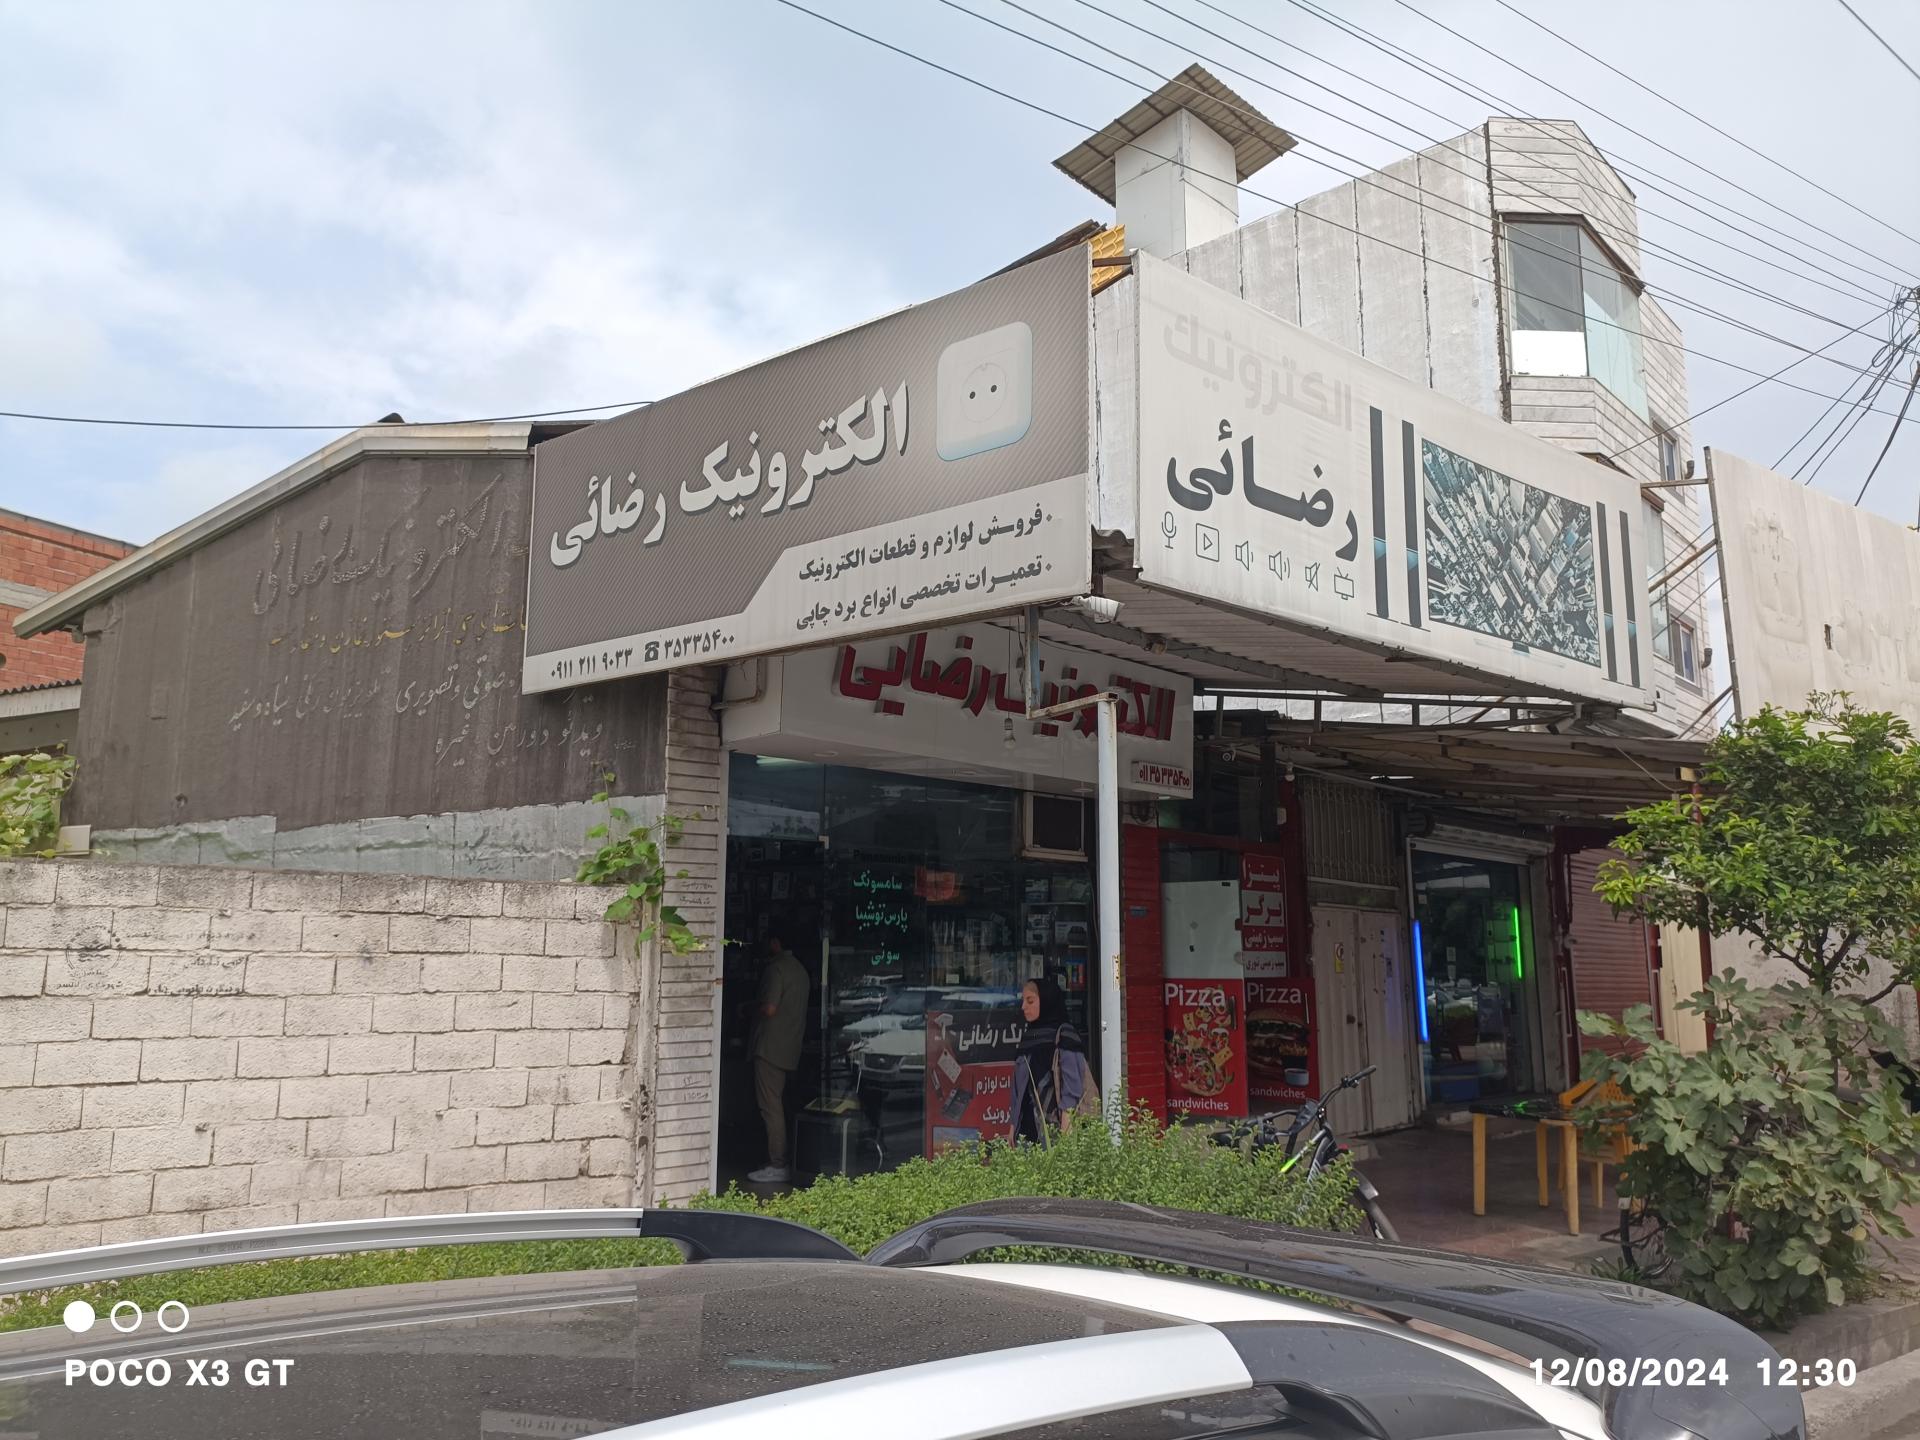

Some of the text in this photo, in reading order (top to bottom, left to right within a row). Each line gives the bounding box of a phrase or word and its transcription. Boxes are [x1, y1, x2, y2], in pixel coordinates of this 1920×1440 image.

[550, 379, 909, 567] الکترونیک رضائی
[799, 502, 1043, 582] فروش لوازم و قطعات الکترونیک
[797, 555, 1042, 630] تعمیرات تخصصی انواع برد چاپی
[664, 628, 735, 660] ۳۵۳۳۵۴۰۰
[551, 647, 634, 680] ۰۹۱۱ ۲۱۱ ۹۰۳۳
[853, 870, 903, 892] سامسونگ
[871, 940, 900, 966] سونی
[1165, 983, 1226, 1007] Pizza
[1247, 982, 1302, 1004] Pizza
[1167, 1097, 1230, 1111] sandwiches
[1249, 1087, 1306, 1099] sandwiches
